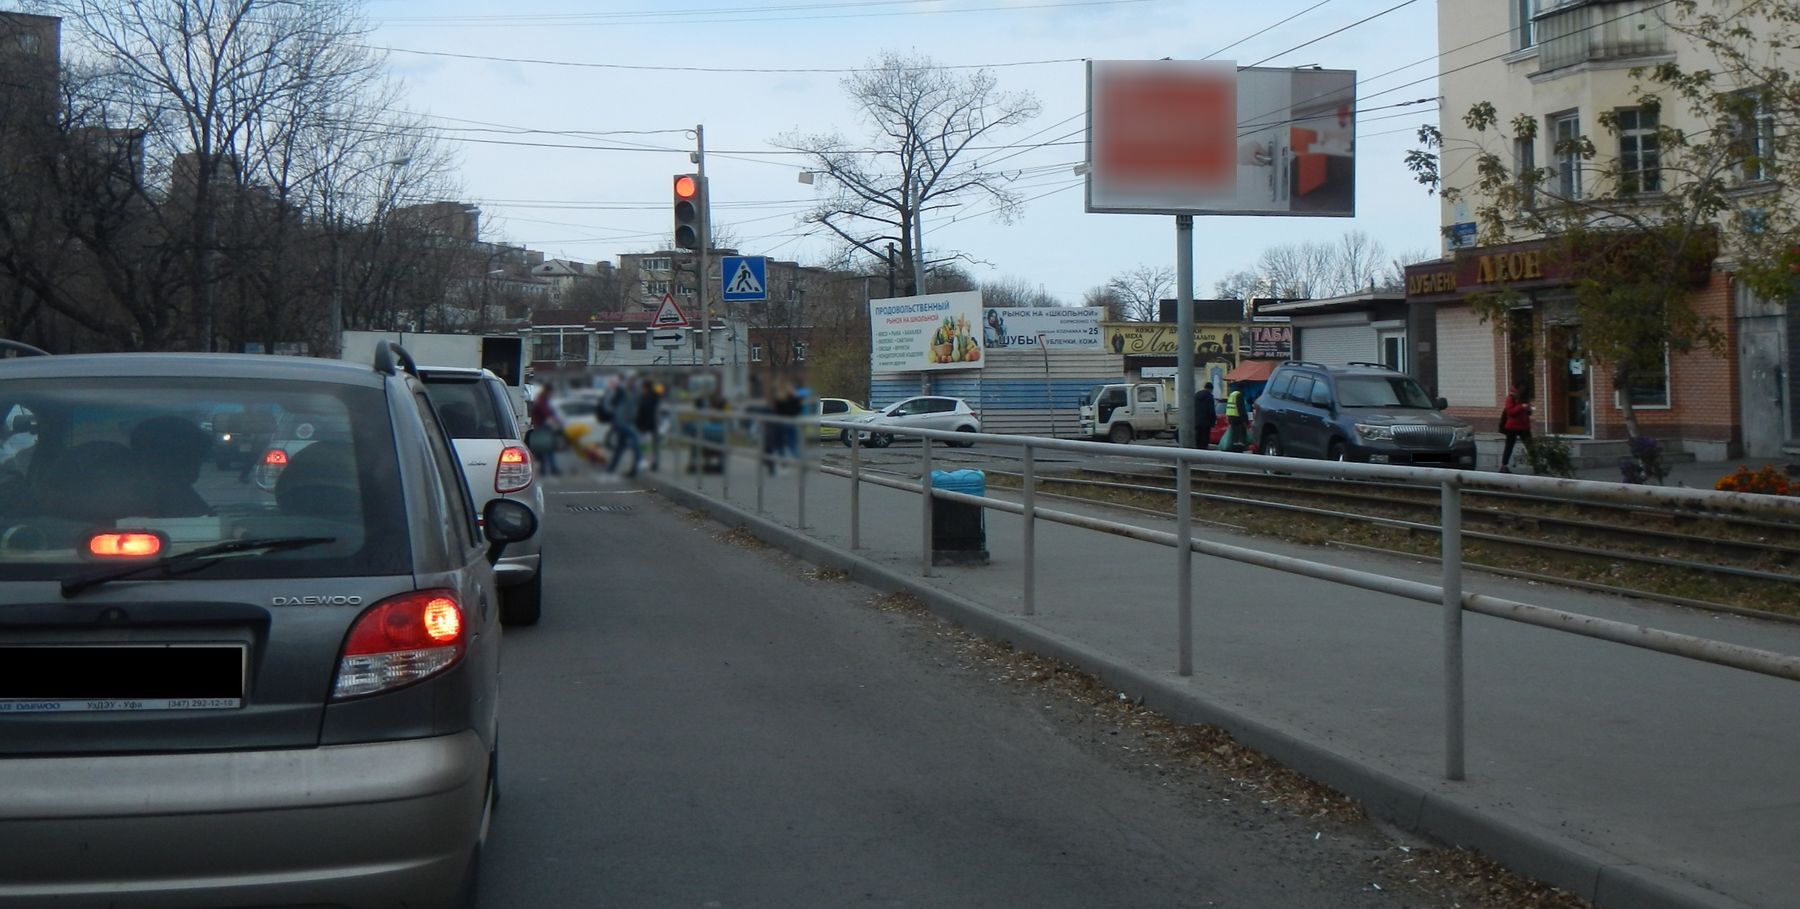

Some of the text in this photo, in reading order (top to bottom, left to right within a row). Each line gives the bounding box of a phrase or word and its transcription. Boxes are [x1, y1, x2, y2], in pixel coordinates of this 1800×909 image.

[875, 300, 950, 315] ПРОДОВОЛЬСТВЕННЫЙ
[1002, 310, 1031, 318] РЫНОК
[1045, 309, 1099, 317] «ШКОЛЬНОЙ»
[1088, 327, 1099, 335] 25
[272, 595, 362, 605] DAEWOO
[16, 702, 61, 710] DAEWOO
